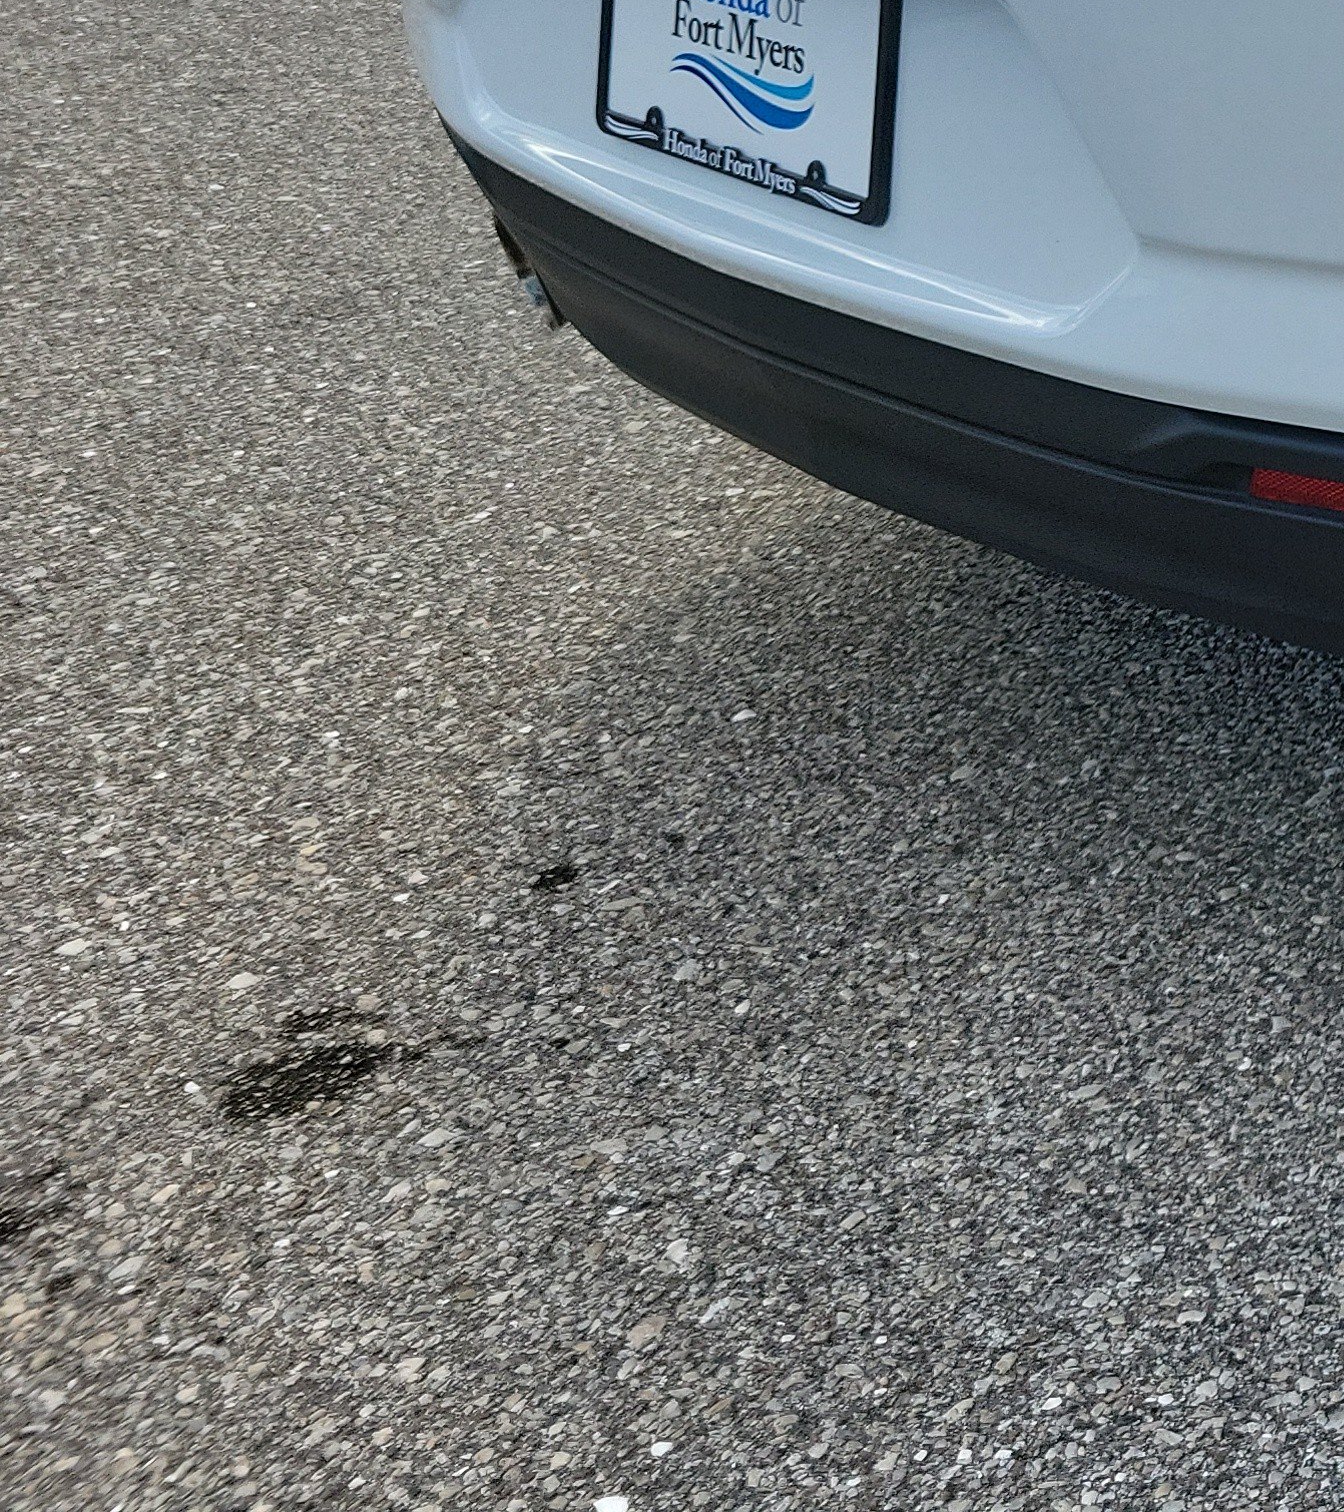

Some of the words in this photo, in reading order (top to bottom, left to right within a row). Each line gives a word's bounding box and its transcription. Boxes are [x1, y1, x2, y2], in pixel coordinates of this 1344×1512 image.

[726, 12, 806, 76] Myers
[664, 128, 708, 165] Honda
[708, 148, 724, 169] of
[724, 147, 755, 182] Fort
[754, 159, 797, 194] Myers
